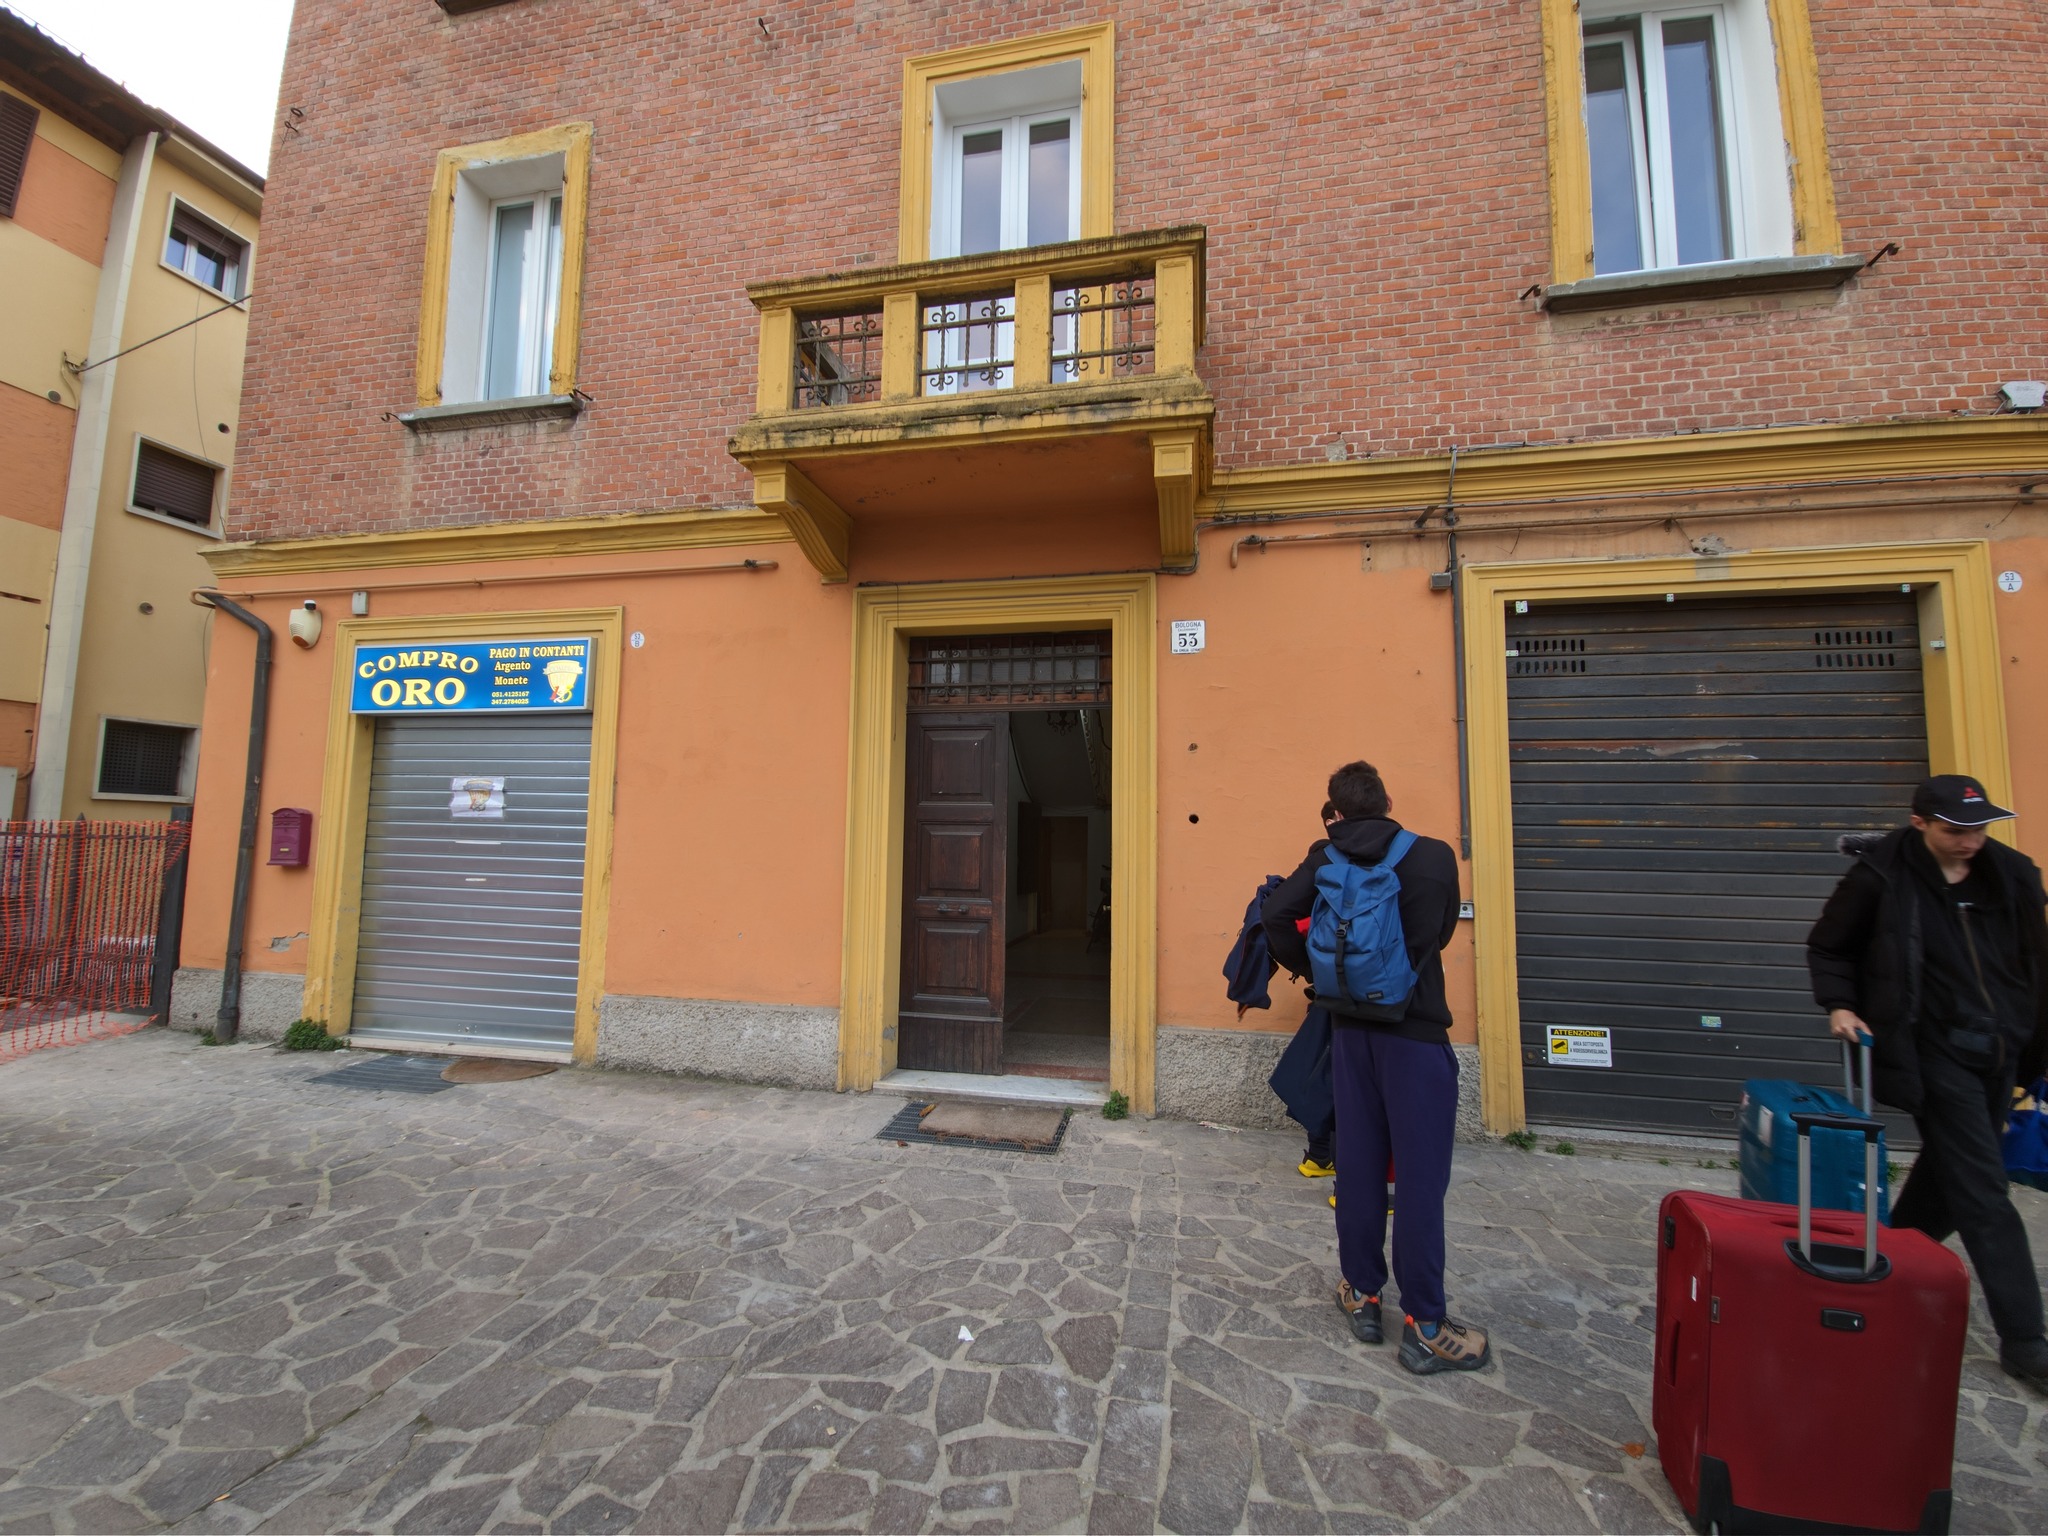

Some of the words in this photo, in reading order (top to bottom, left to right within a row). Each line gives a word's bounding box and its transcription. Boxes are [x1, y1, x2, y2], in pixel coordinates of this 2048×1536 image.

[2004, 572, 2015, 581] 53
[2007, 582, 2014, 591] A
[1175, 621, 1202, 629] BOLOGNA
[1178, 632, 1198, 648] 53
[489, 647, 517, 659] PAGO
[519, 647, 531, 658] IN
[533, 645, 585, 657] CONTANTI
[359, 651, 479, 678] COMPRO
[494, 660, 531, 673] Argento
[494, 676, 528, 686] Monete
[371, 677, 466, 707] ORO
[1553, 1029, 1605, 1037] ATTENZIONE!
